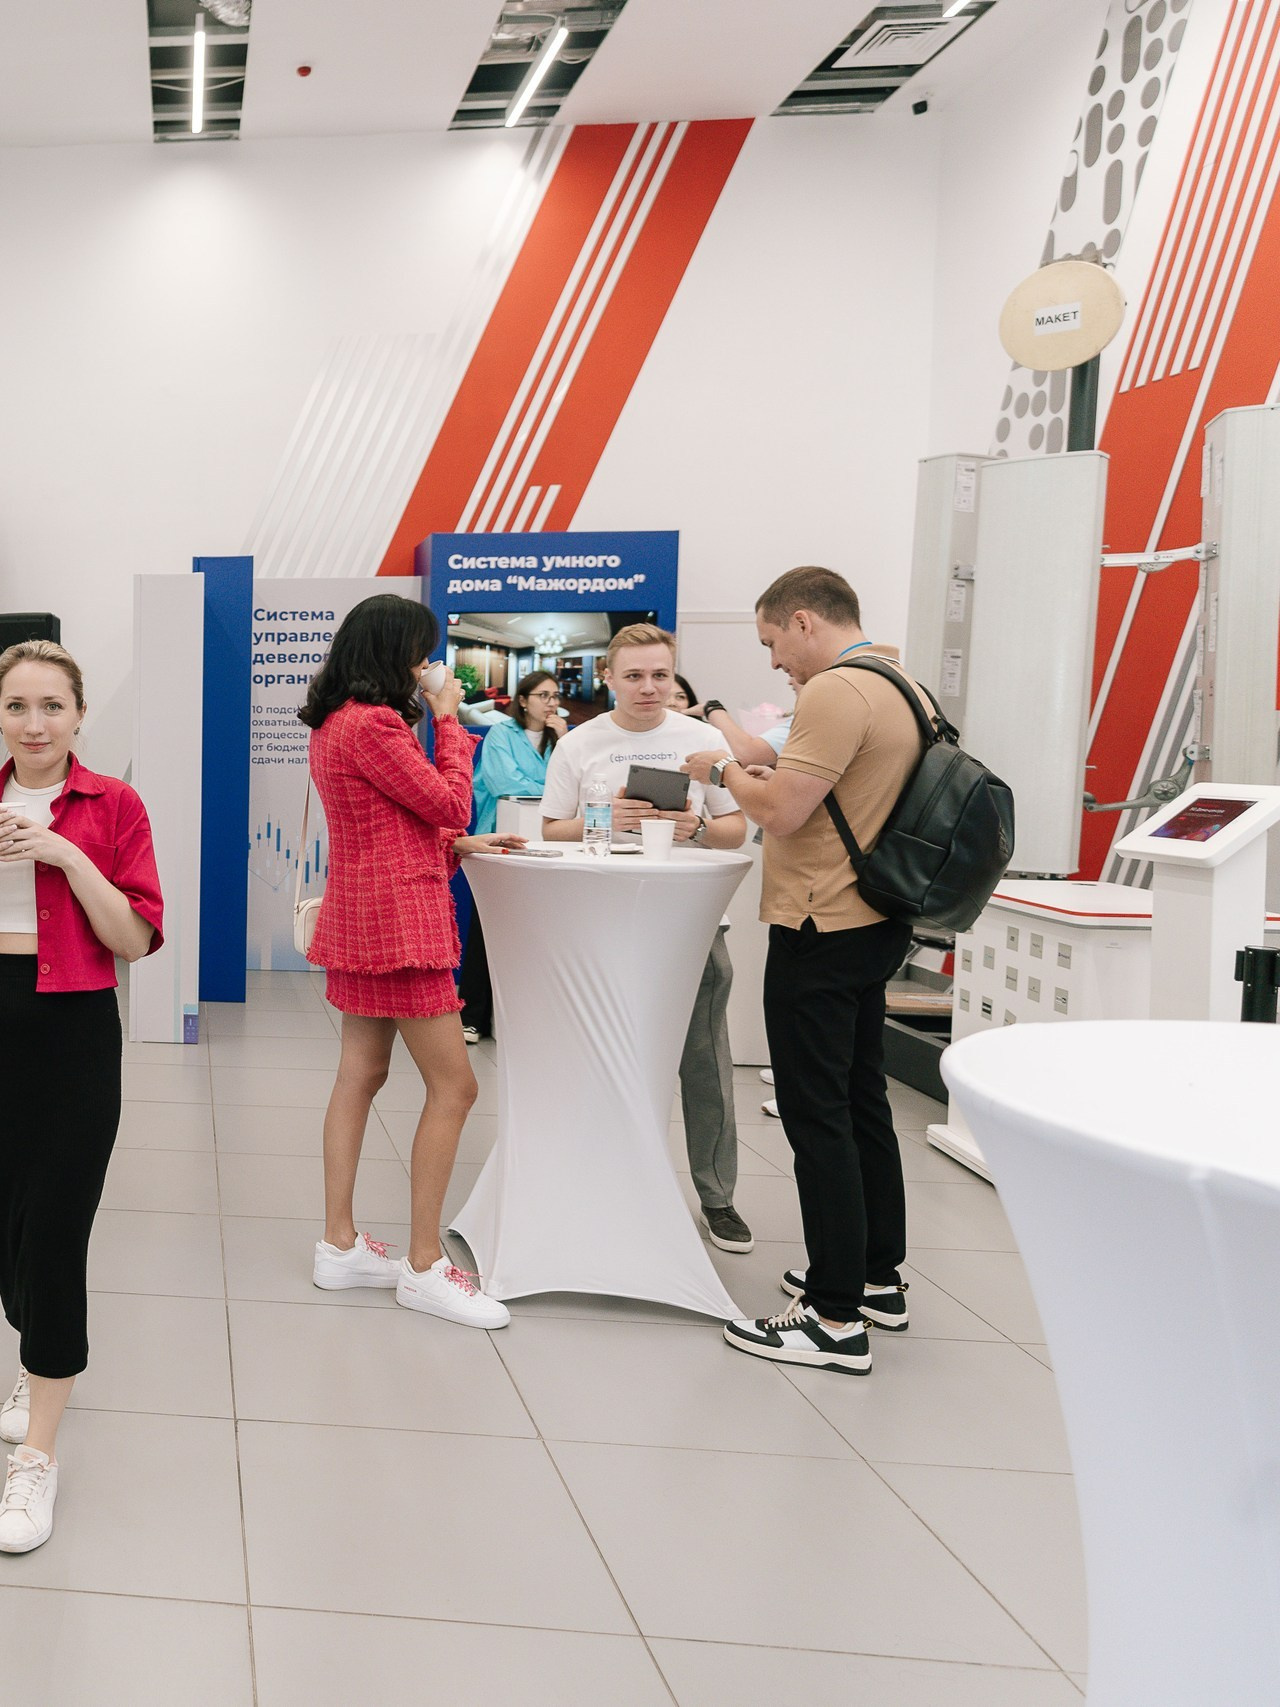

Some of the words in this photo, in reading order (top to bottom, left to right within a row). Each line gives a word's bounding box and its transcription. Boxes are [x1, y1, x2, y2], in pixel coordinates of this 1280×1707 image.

[1035, 310, 1079, 326] МАКЕТ
[448, 554, 538, 570] Система
[542, 555, 621, 572] умного
[447, 578, 502, 594] дома
[253, 608, 335, 621] Система
[252, 674, 313, 688] орган
[252, 705, 263, 714] 10
[252, 732, 308, 741] процессы
[252, 757, 284, 765] сдачи
